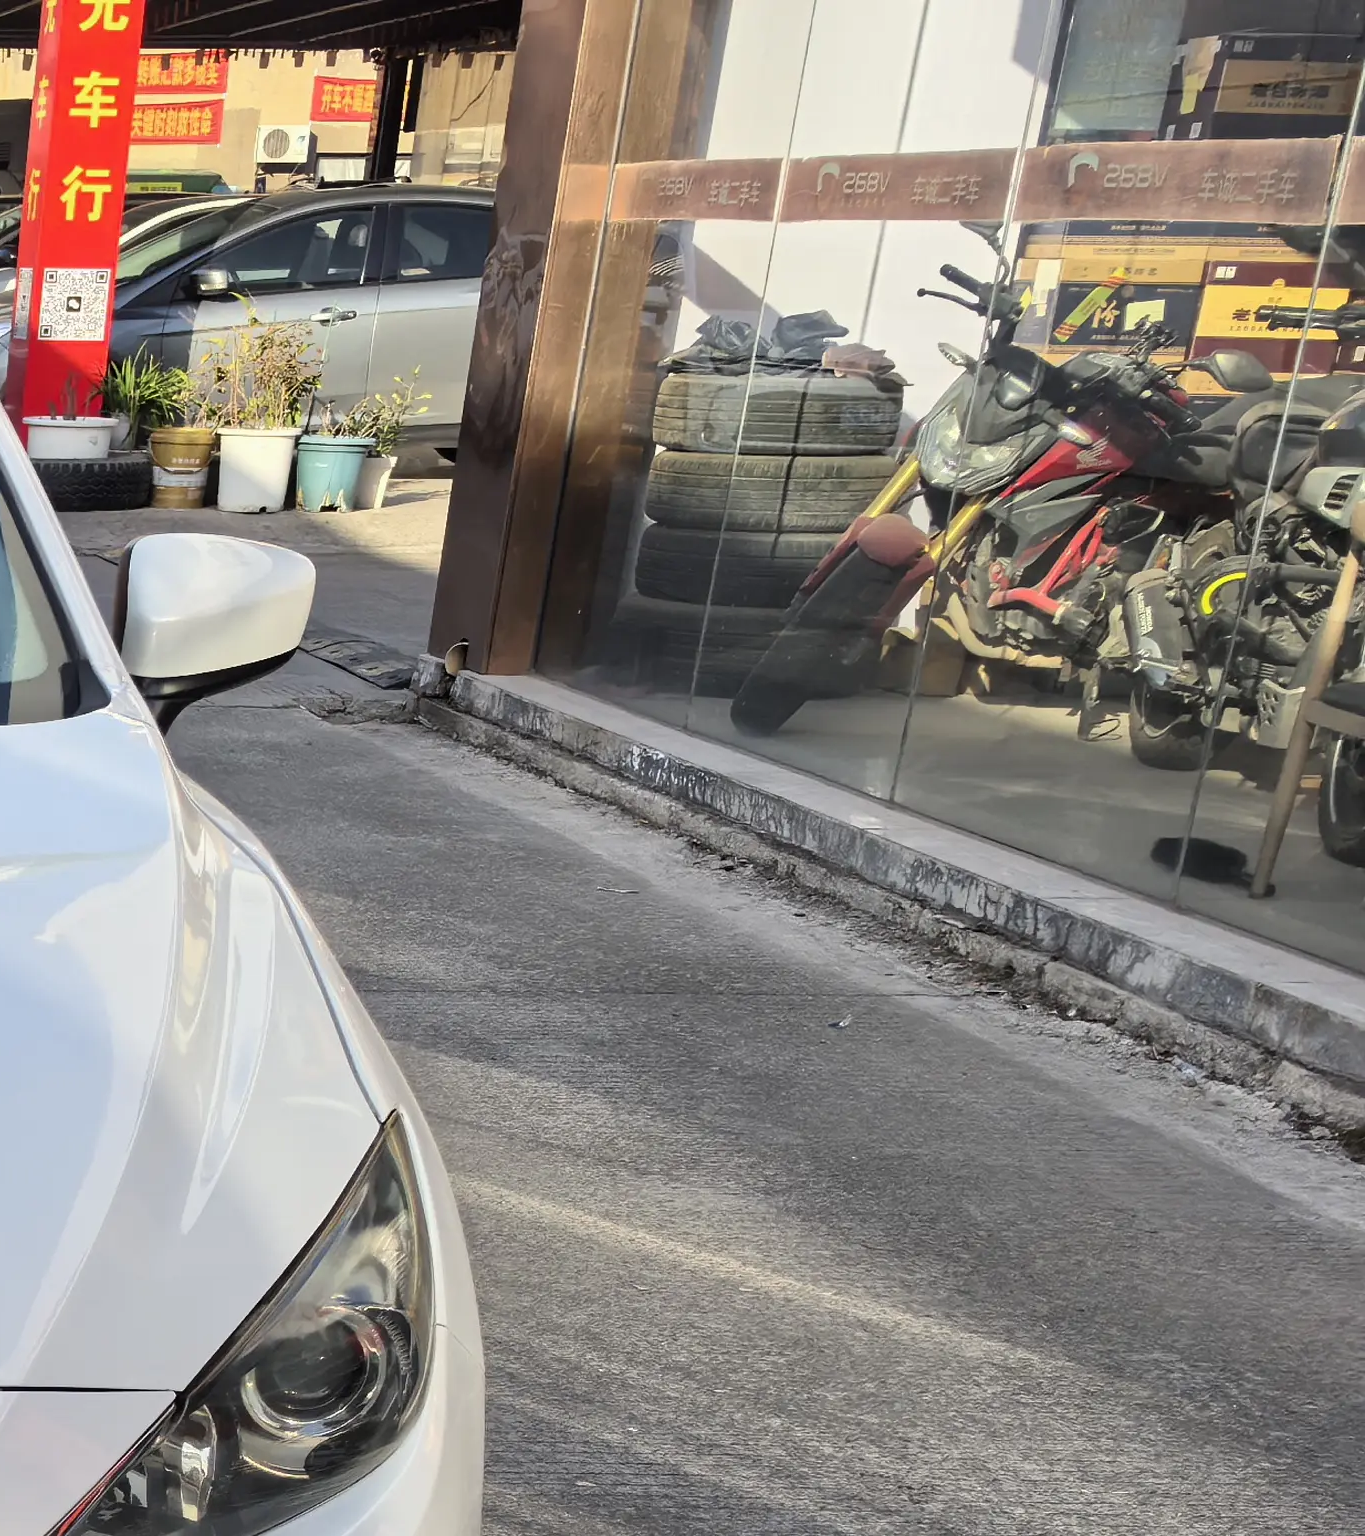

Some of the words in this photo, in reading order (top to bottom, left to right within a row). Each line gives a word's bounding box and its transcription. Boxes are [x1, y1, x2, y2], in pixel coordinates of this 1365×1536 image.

[131, 107, 212, 136] 关键时刻救性命
[842, 172, 891, 194] 268V
[1103, 163, 1169, 188] 268V
[1198, 168, 1298, 203] 车诚二手车
